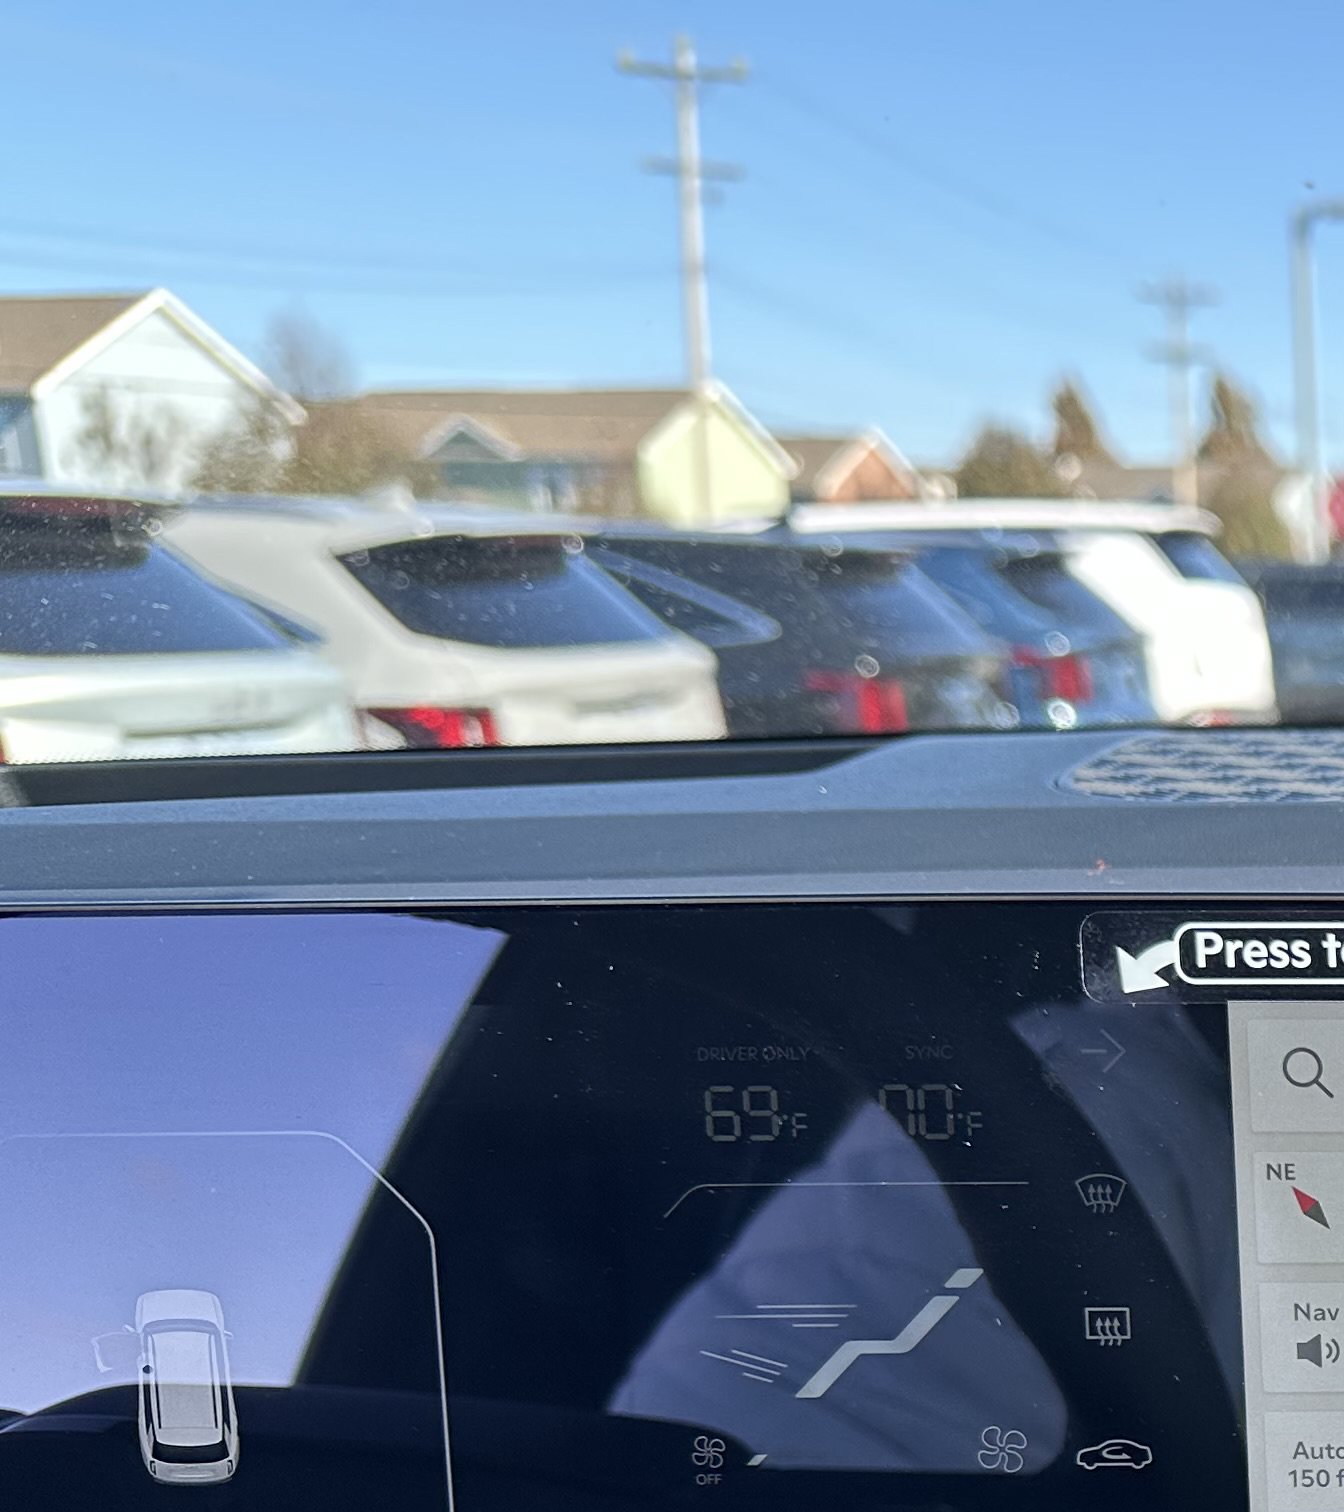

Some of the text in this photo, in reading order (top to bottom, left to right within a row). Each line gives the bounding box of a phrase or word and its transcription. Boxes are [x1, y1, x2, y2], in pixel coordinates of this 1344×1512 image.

[1193, 930, 1312, 970] Press
[697, 1045, 809, 1062] DRIVER ONLY
[905, 1045, 954, 1059] SYNC
[1266, 1163, 1297, 1181] NE
[1293, 1303, 1339, 1322] Nav
[696, 1473, 723, 1486] OFF
[1288, 1468, 1331, 1488] 150
